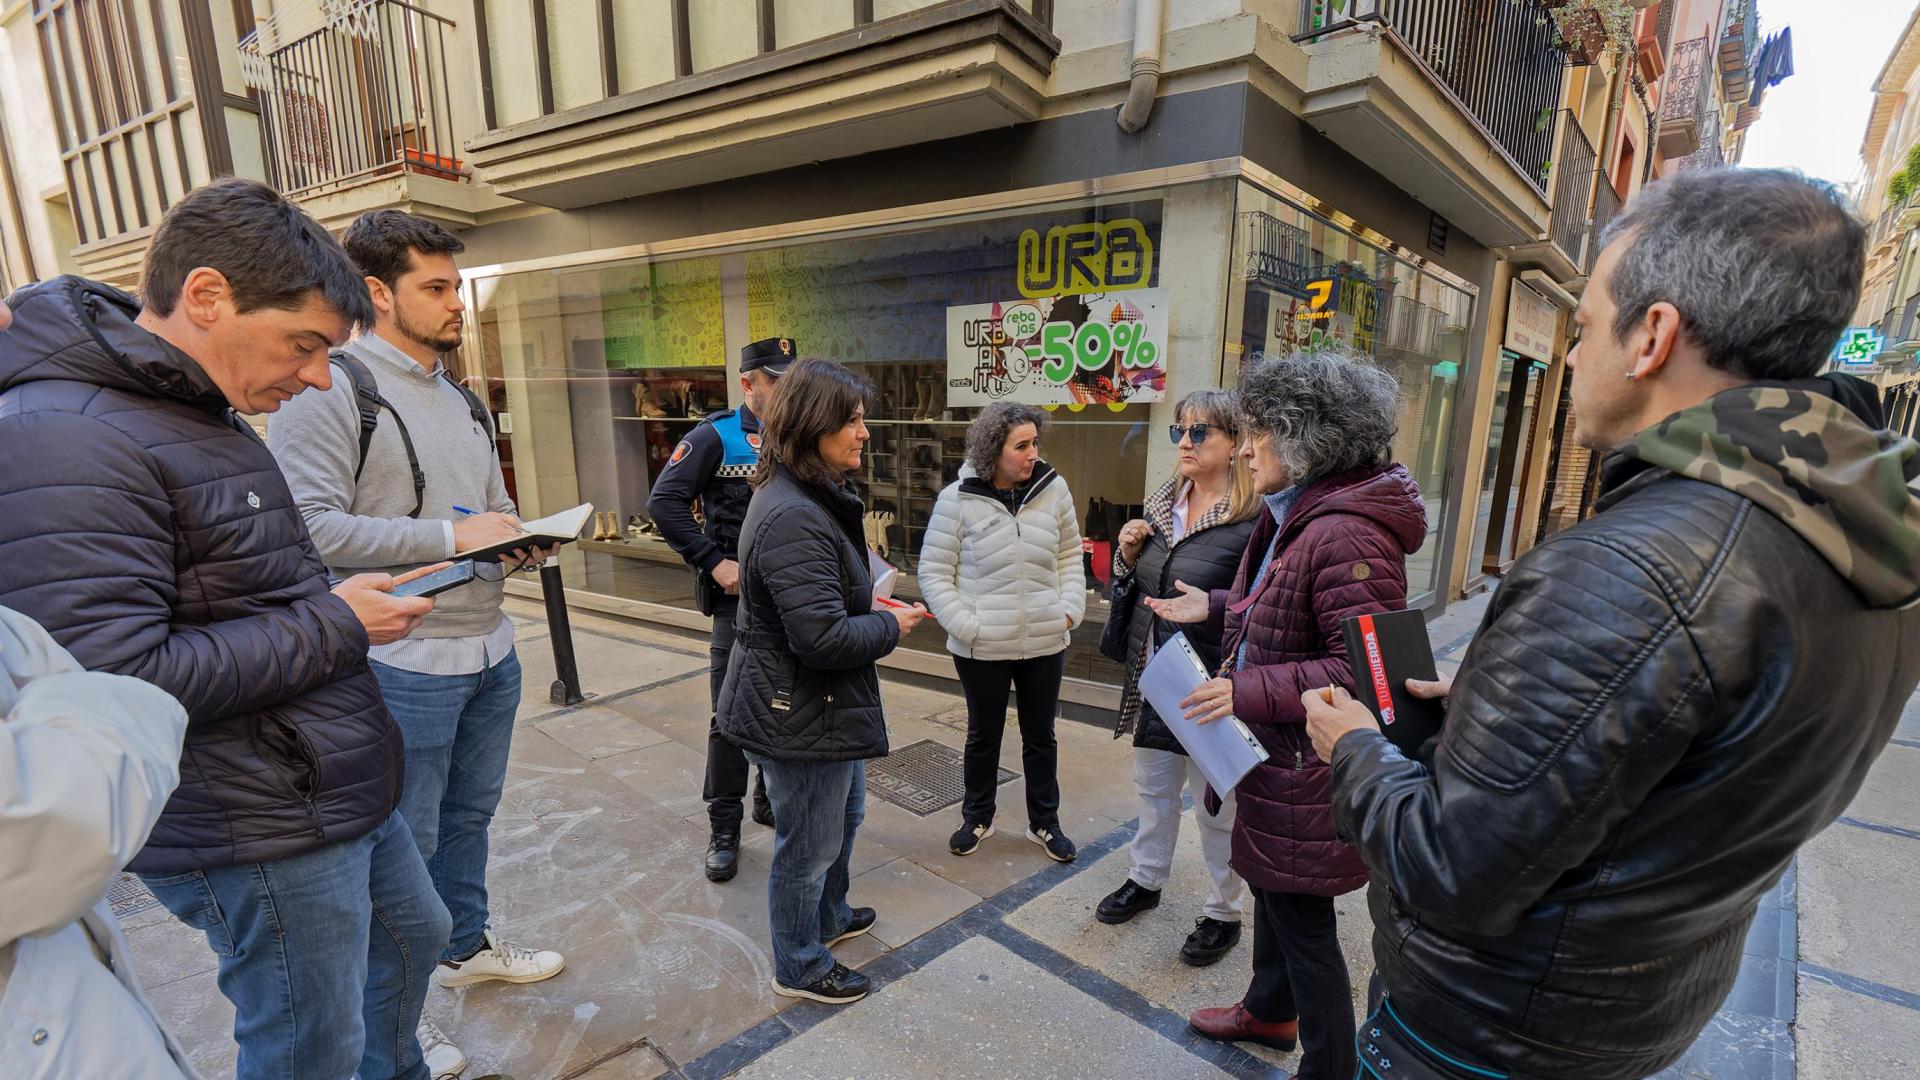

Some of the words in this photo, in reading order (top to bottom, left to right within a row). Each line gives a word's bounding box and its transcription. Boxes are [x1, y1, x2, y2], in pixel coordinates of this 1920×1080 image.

[1006, 310, 1036, 324] reba
[1016, 322, 1036, 337] jas
[1026, 321, 1157, 384] -50%
